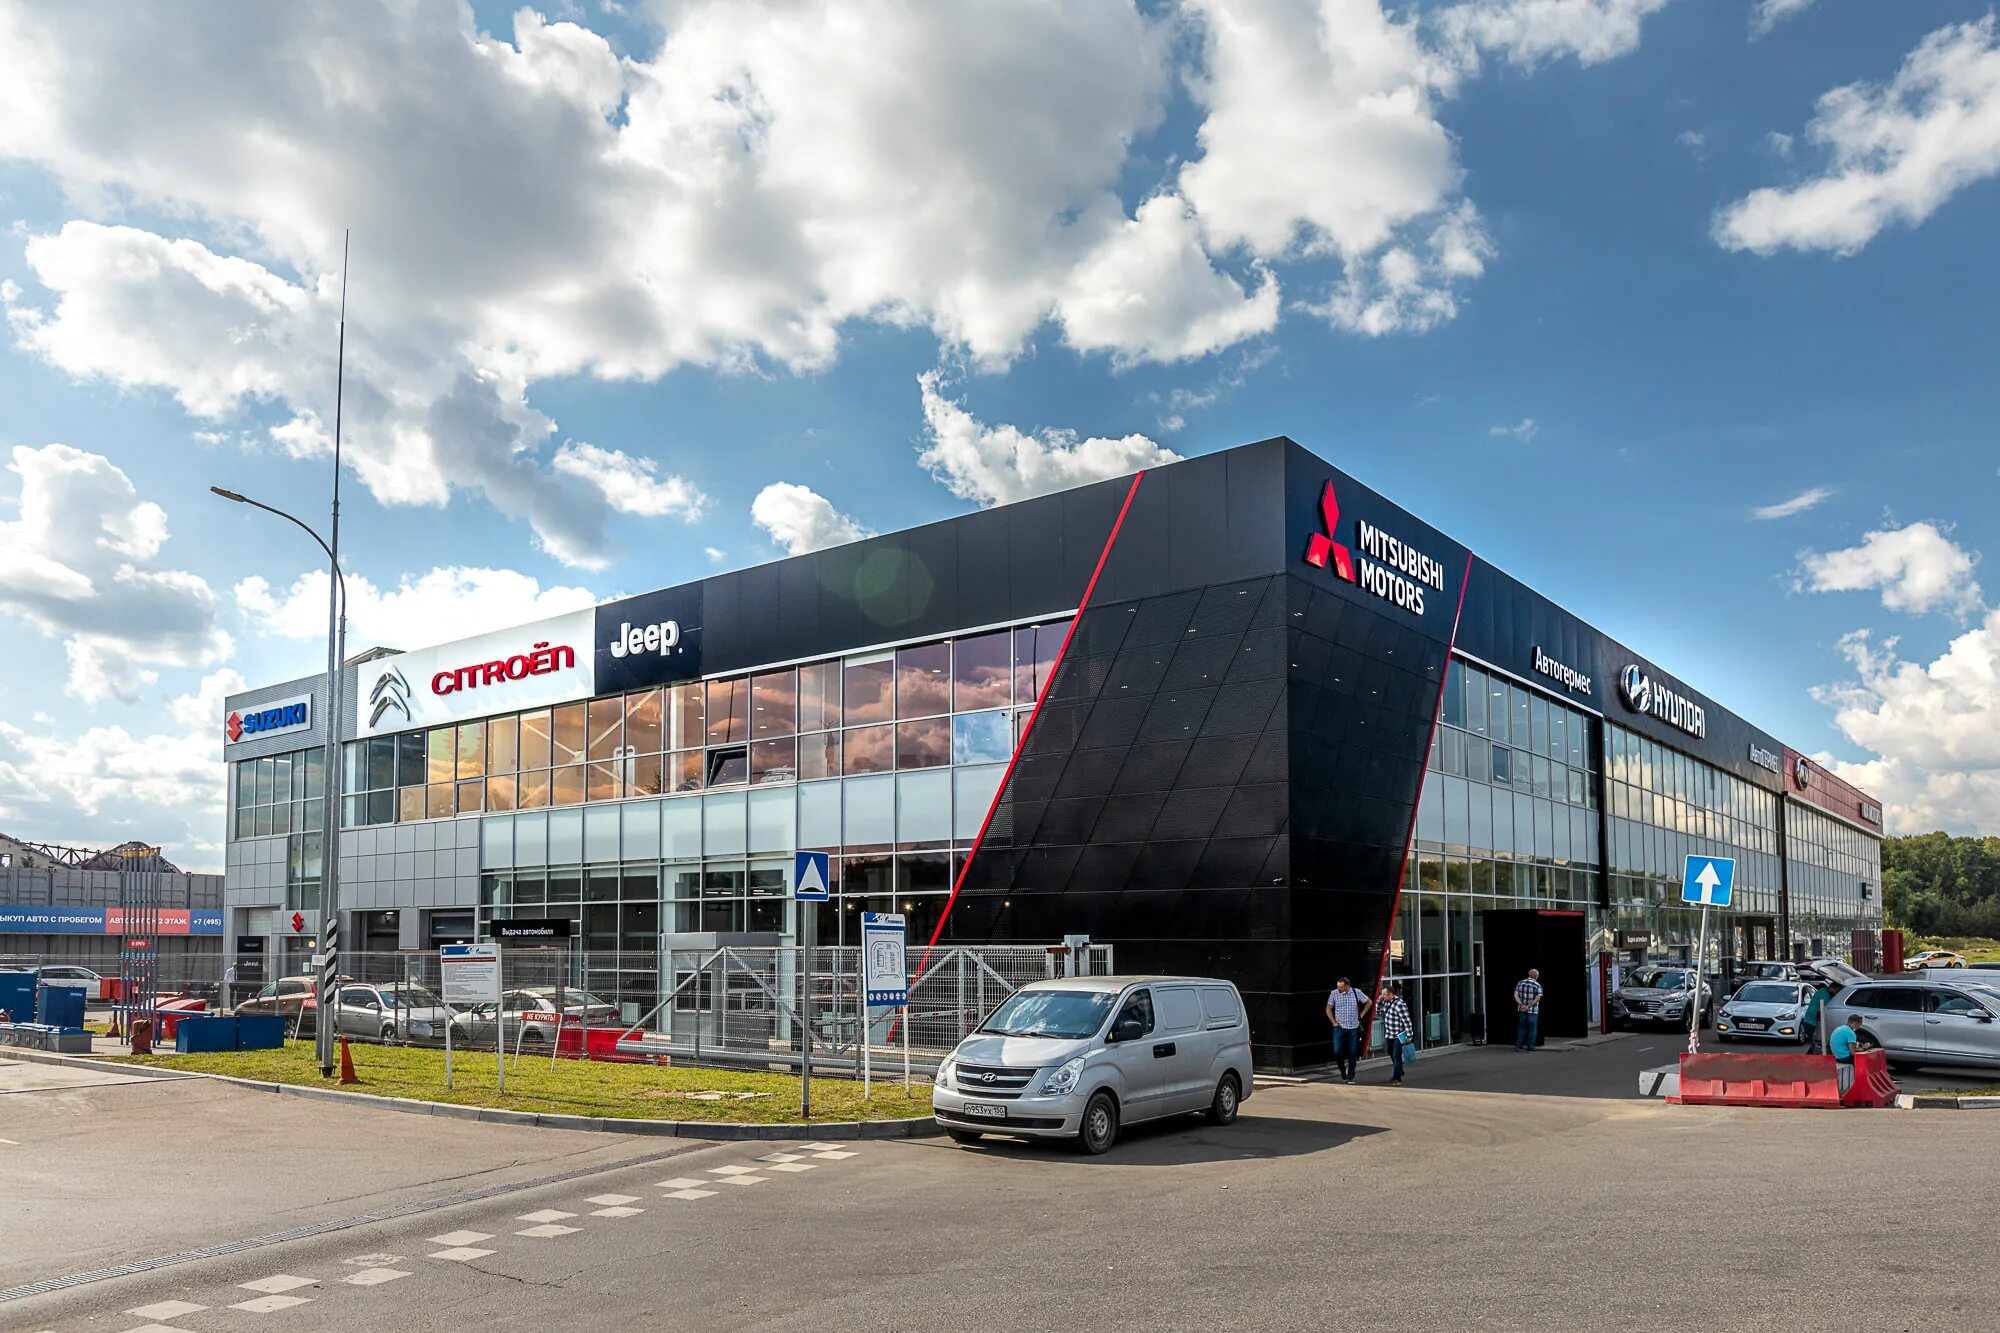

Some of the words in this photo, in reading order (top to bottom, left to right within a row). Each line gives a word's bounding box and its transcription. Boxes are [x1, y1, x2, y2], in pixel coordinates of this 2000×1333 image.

[1360, 519, 1444, 591] MITSUBISHI
[1360, 558, 1425, 615] MOTORS
[1535, 645, 1592, 695] Автогермес
[243, 702, 306, 733] SUZUKI
[1653, 681, 1706, 739] HYUNDAI
[26, 915, 49, 923] АВТО
[58, 916, 102, 924] ПРОБЕГОМ
[158, 917, 164, 925] 2
[164, 917, 187, 925] ЭТАЖ
[203, 918, 222, 926] (495)
[502, 927, 522, 936] Выдача
[522, 927, 554, 936] автомобиля
[534, 1014, 556, 1022] КУРИТЬ!
